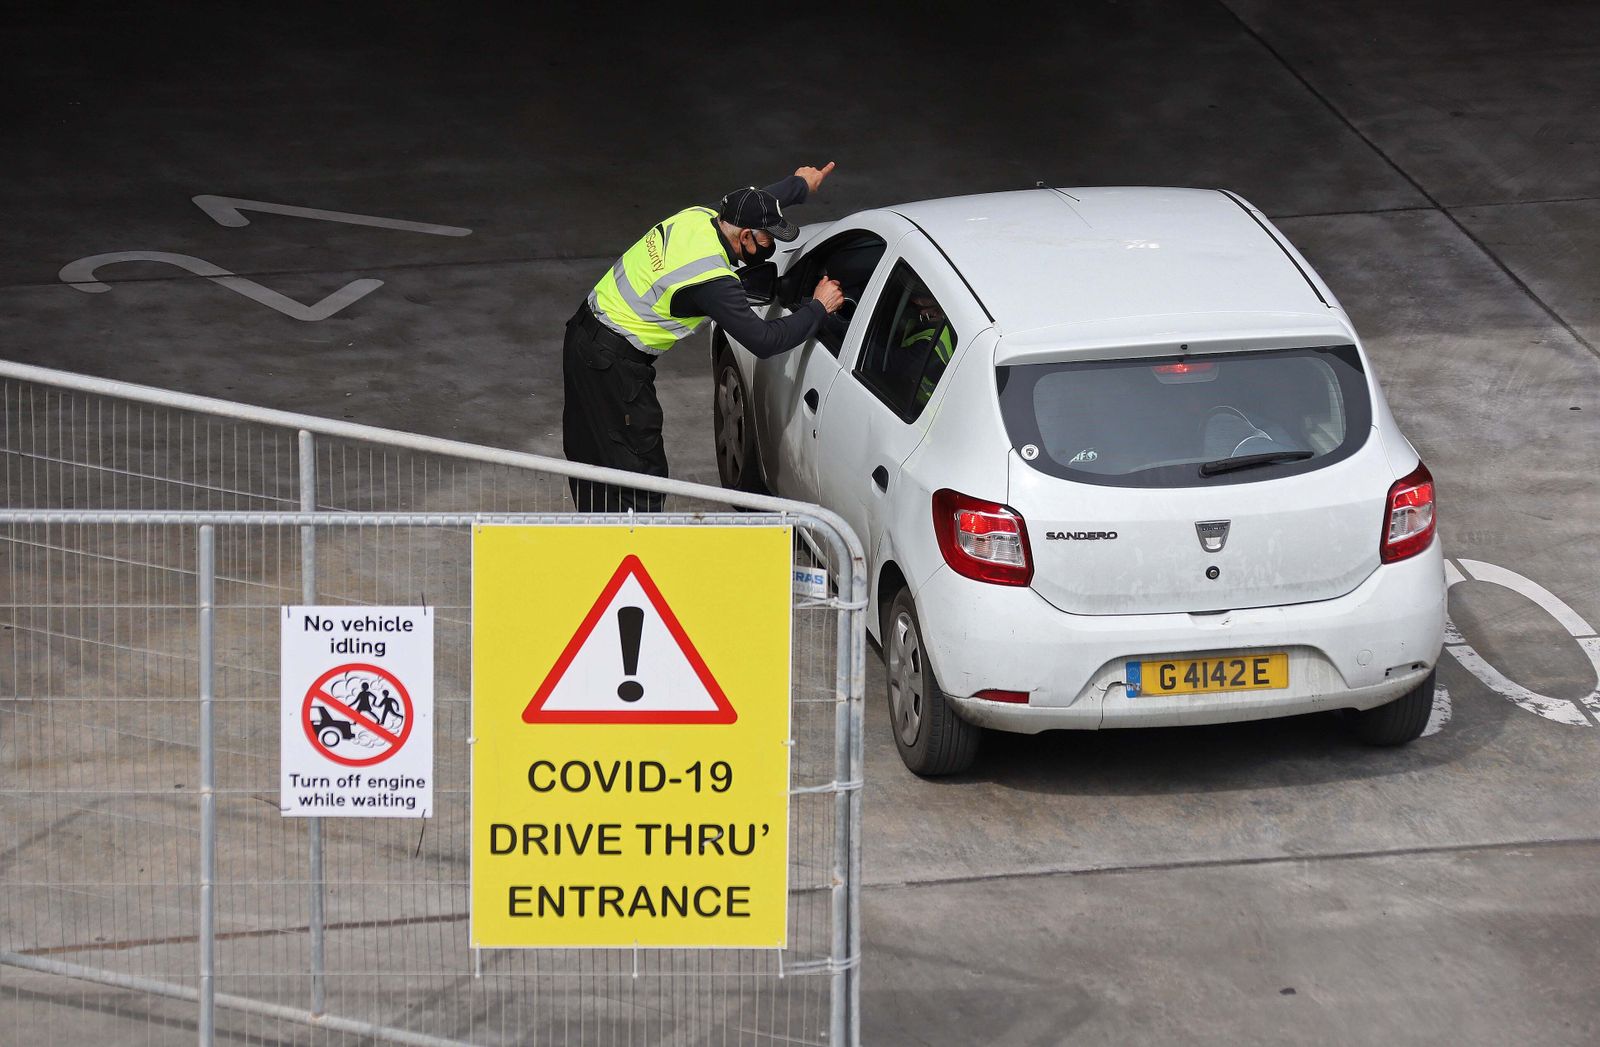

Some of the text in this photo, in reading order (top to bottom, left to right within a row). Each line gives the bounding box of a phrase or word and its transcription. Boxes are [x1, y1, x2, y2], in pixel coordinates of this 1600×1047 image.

[1045, 531, 1119, 541] SANDERO
[793, 571, 825, 585] RAS
[304, 615, 414, 632] No vehicle
[330, 637, 387, 657] idling
[289, 773, 426, 791] Turn off engine
[527, 760, 733, 793] COVID-19
[298, 793, 416, 810] while waiting
[490, 823, 623, 856] DRIVE
[508, 885, 751, 918] ENTRANCE
